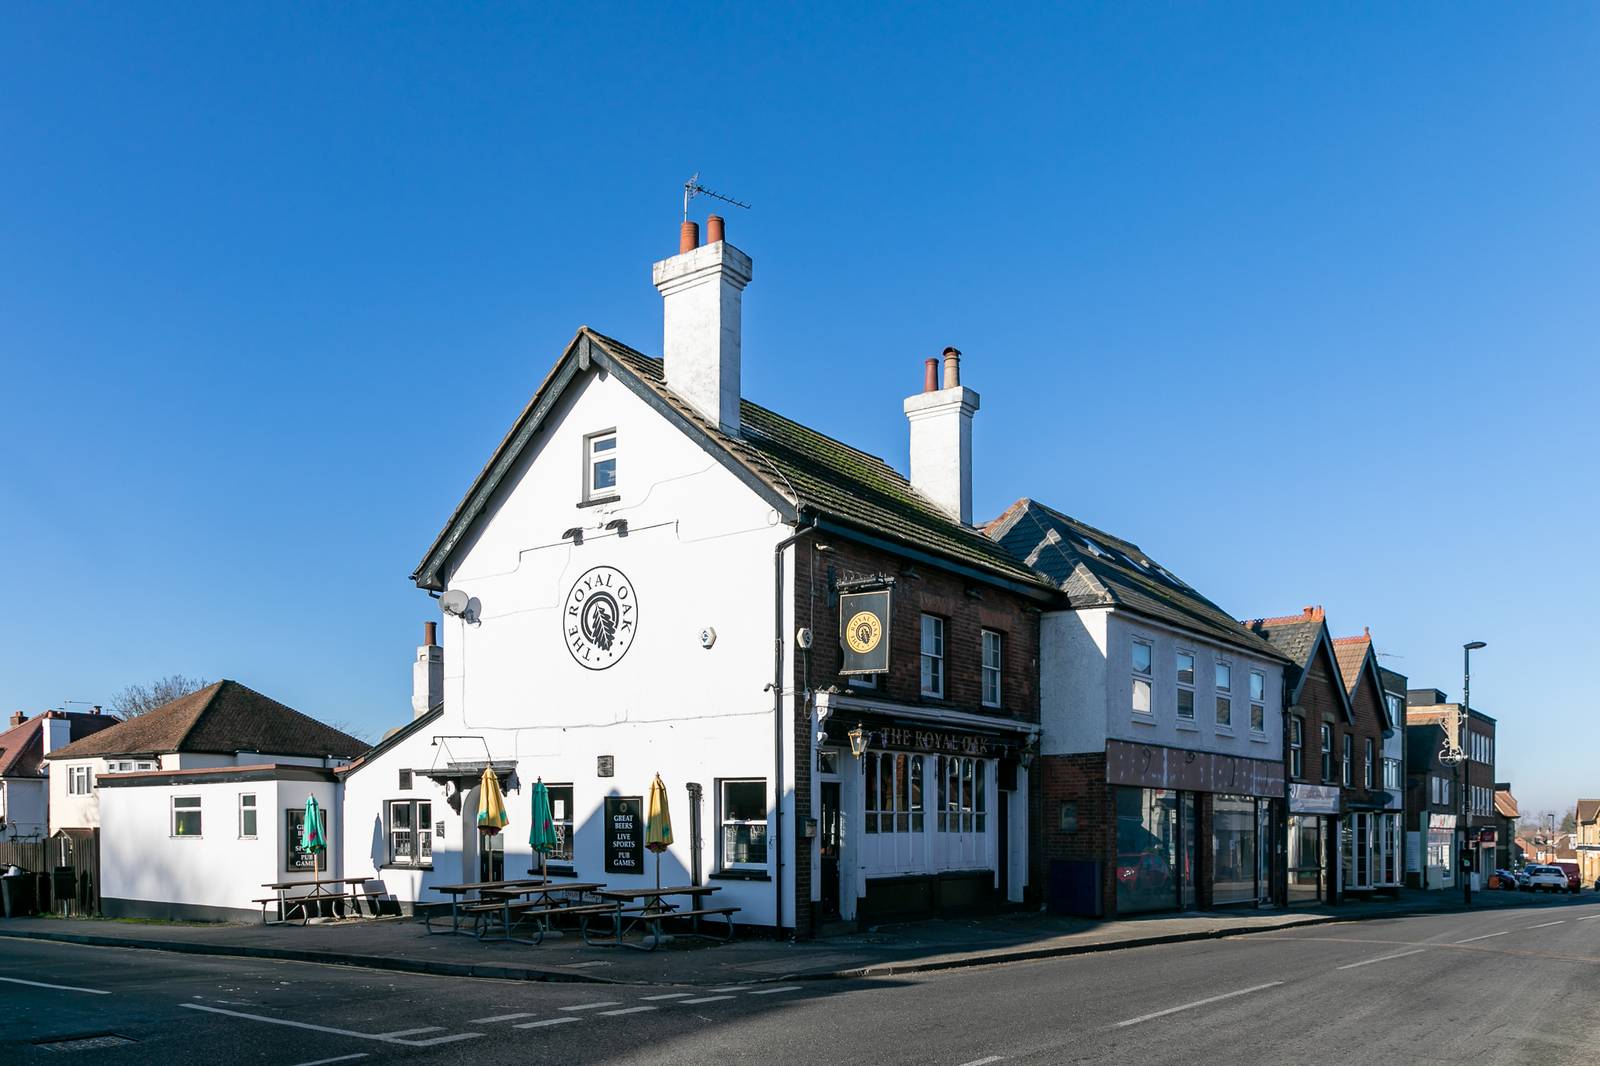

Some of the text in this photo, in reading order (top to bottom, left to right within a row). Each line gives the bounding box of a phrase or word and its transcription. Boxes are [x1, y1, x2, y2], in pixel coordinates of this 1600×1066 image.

[568, 573, 632, 661] THE ROYAL OAK
[881, 727, 988, 753] THE ROYAL OAK
[614, 814, 633, 822] GREAT
[612, 840, 636, 848] SPORTS
[618, 851, 630, 859] PUB
[613, 859, 635, 867] GAMES
